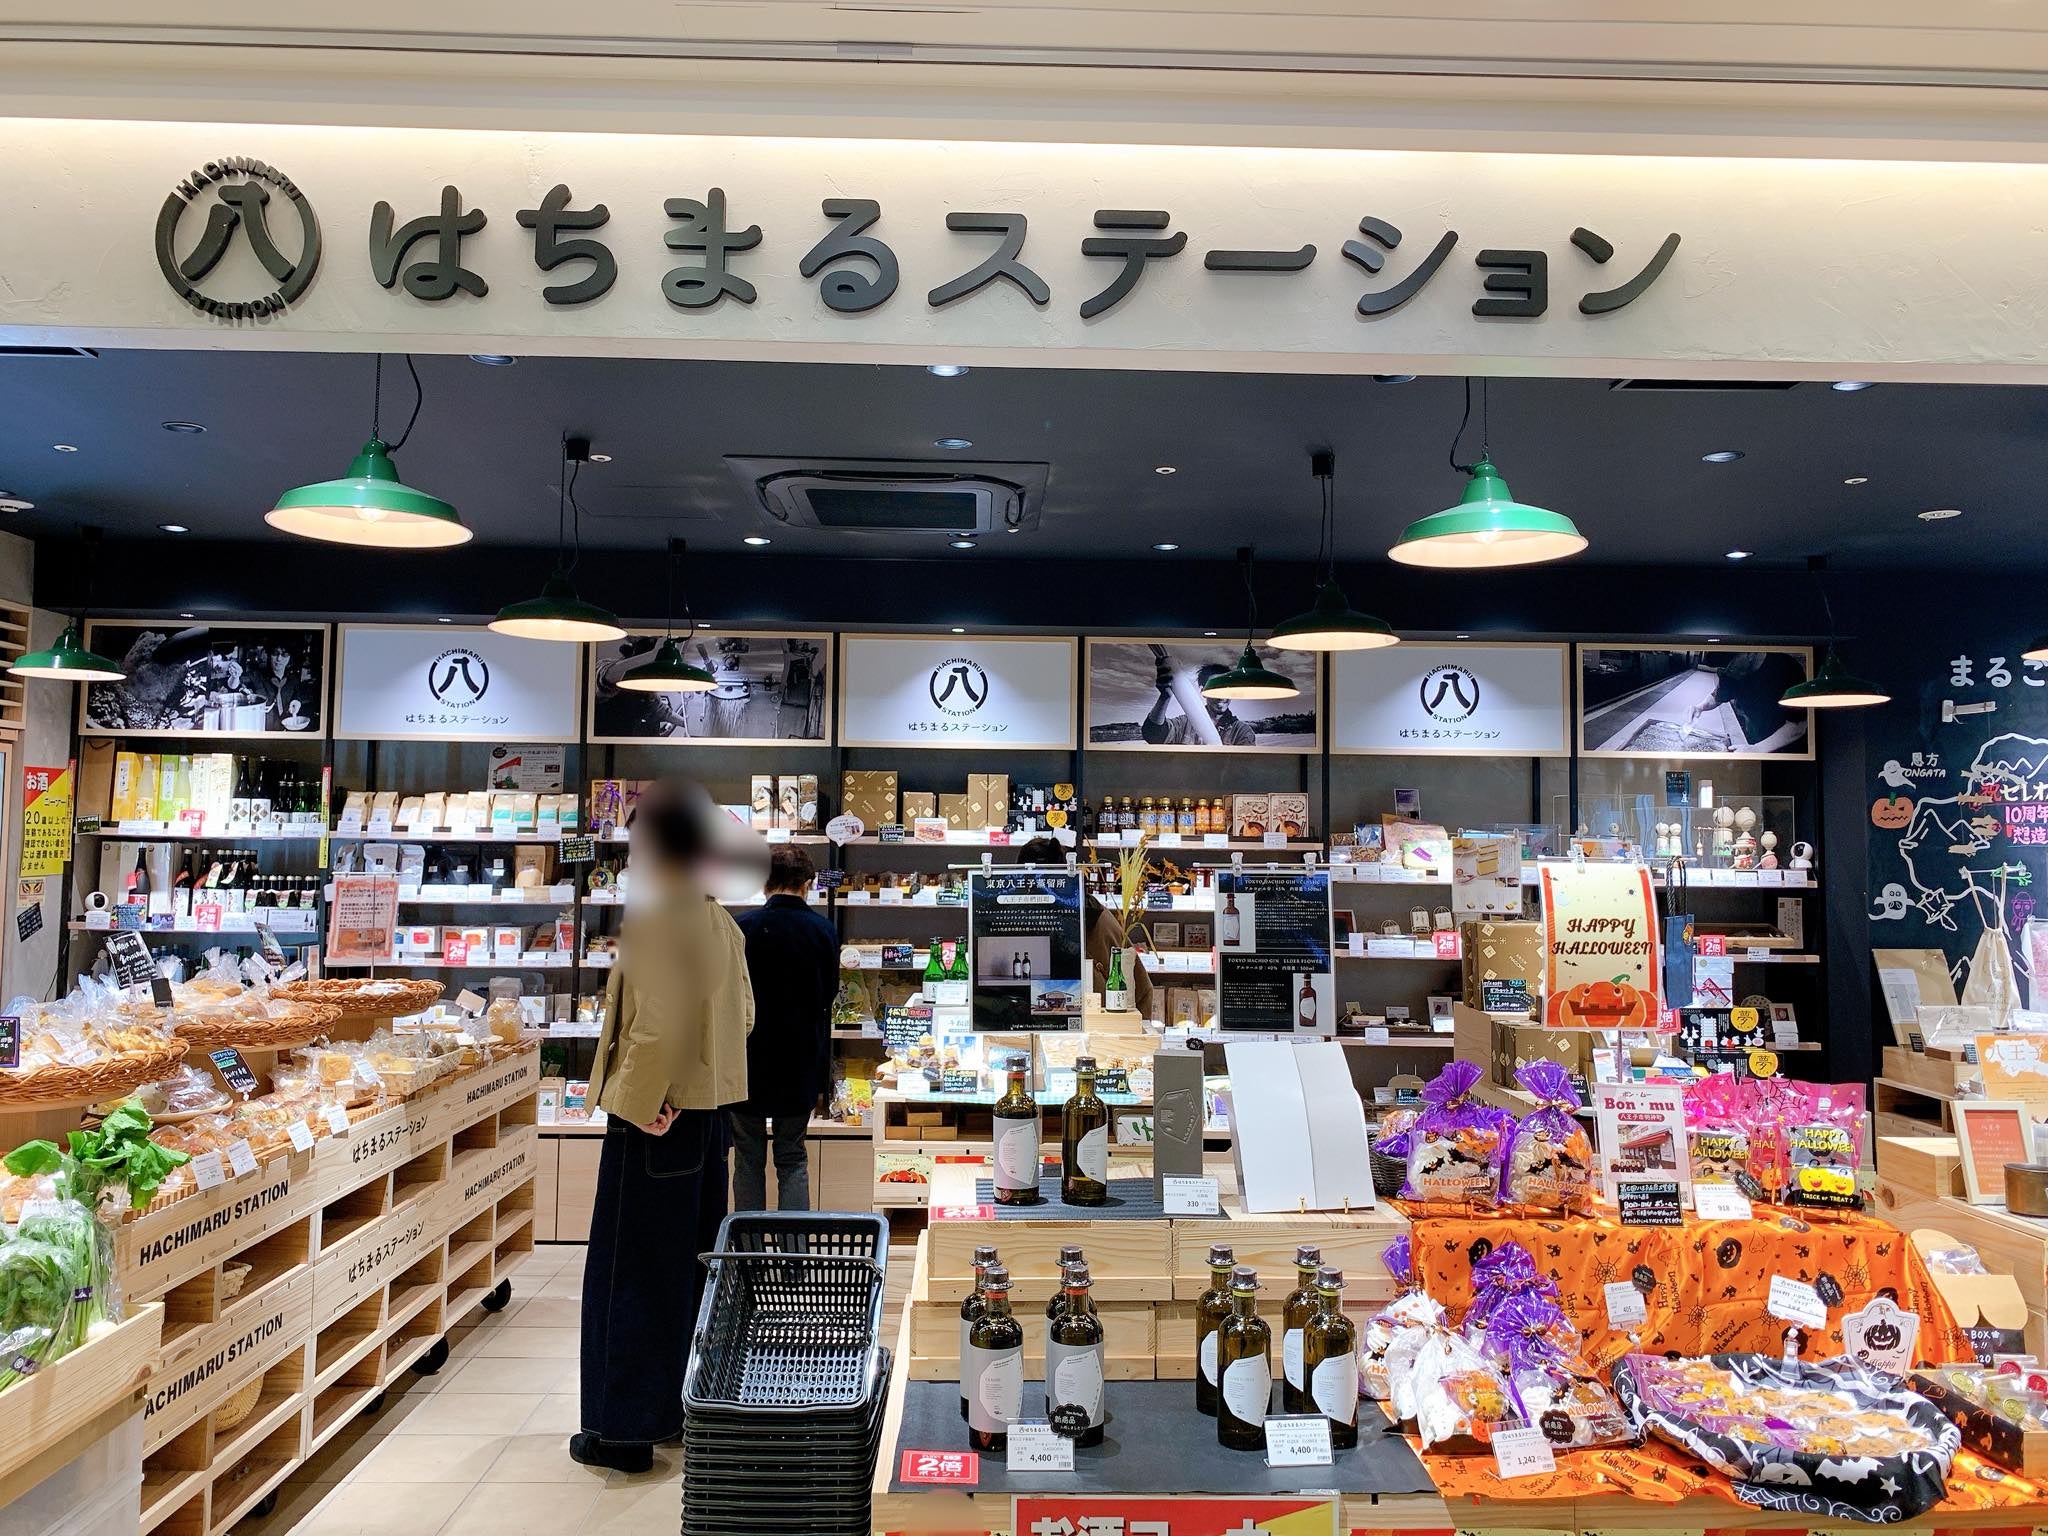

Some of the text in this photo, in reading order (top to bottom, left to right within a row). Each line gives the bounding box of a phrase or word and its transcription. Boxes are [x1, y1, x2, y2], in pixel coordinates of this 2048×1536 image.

[176, 155, 303, 201] HACHIMARU
[180, 180, 297, 284] 八
[369, 183, 1682, 317] はちまるステーション
[186, 287, 288, 320] STATION
[436, 647, 484, 664] HACHIMARU
[936, 657, 983, 673] HACHIMARU
[1426, 663, 1474, 679] HACHIMARU
[438, 656, 480, 694] 八
[939, 665, 979, 702] 八
[1430, 672, 1471, 709] 八
[440, 698, 476, 709] STATION
[941, 706, 976, 717] STATION
[1432, 713, 1467, 724] STATION
[405, 713, 510, 726] はちまるステーション
[908, 721, 1009, 732] はちまるステーション
[1399, 728, 1501, 739] はちまるステーション
[26, 772, 49, 792] お酒
[21, 862, 46, 872] しません
[985, 878, 1066, 889] 東京八王子蒸留所
[1567, 918, 1636, 939] HAPPY
[1438, 938, 1455, 950] 2倍
[1551, 941, 1653, 955] HALLOWEEN
[1705, 942, 1721, 953] 2倍
[1660, 1011, 1674, 1023] 倍
[1737, 1010, 1754, 1025] 夢
[1989, 1043, 2044, 1061] 八王子
[1756, 1055, 1773, 1070] 夢
[466, 1066, 528, 1104] HACHIMARU STATION
[352, 1114, 428, 1164] はちまるステーション
[1804, 1128, 1844, 1139] HAPPY
[1700, 1137, 1739, 1147] HAPPY
[1790, 1139, 1856, 1153] HALLOWEEN
[464, 1152, 526, 1201] HACHIMARU STATION
[1423, 1177, 1490, 1187] HALLOWEEN
[1528, 1177, 1591, 1195] HALLOWEEN
[1717, 1204, 1730, 1212] 918
[139, 1179, 289, 1267] HACHIMARU STATION
[348, 1221, 425, 1283] はちまるステーション
[1908, 1281, 1934, 1324] Happy Halloween
[1711, 1319, 1750, 1353] Happy Halloween
[1971, 1330, 1991, 1340] BOX
[143, 1312, 283, 1420] ACHIMARU STATION
[1869, 1358, 1897, 1370] Happy
[1054, 1415, 1076, 1425] 新商品
[1544, 1420, 1563, 1430] 新商品
[1290, 1446, 1312, 1455] 4,400
[917, 1457, 963, 1472] 2倍
[1029, 1454, 1052, 1463] 4,400
[1517, 1455, 1537, 1466] 1,242
[1601, 1450, 1639, 1485] Halloween
